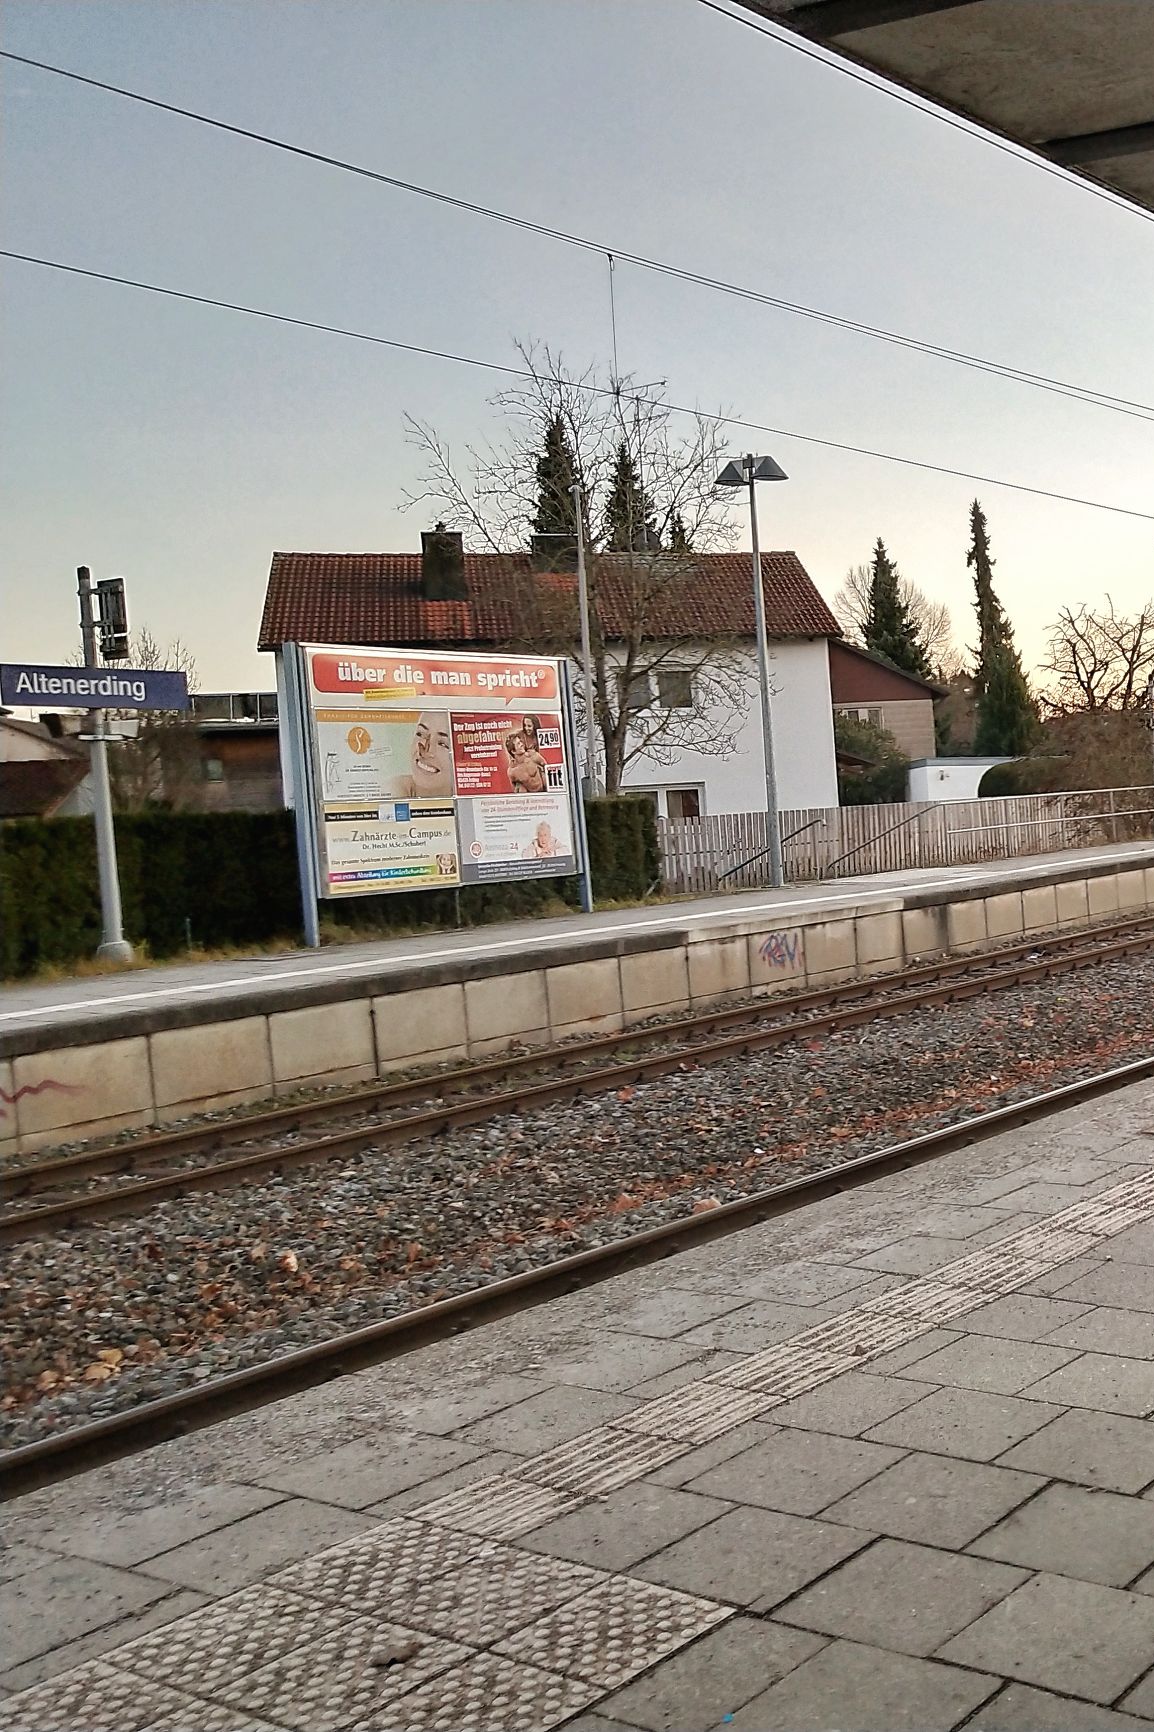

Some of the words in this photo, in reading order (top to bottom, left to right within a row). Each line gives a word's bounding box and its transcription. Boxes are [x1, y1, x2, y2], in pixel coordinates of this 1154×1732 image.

[16, 672, 146, 701] Altenerding
[337, 661, 386, 683] über
[393, 665, 425, 685] die
[431, 670, 472, 687] man
[547, 769, 564, 787] fit
